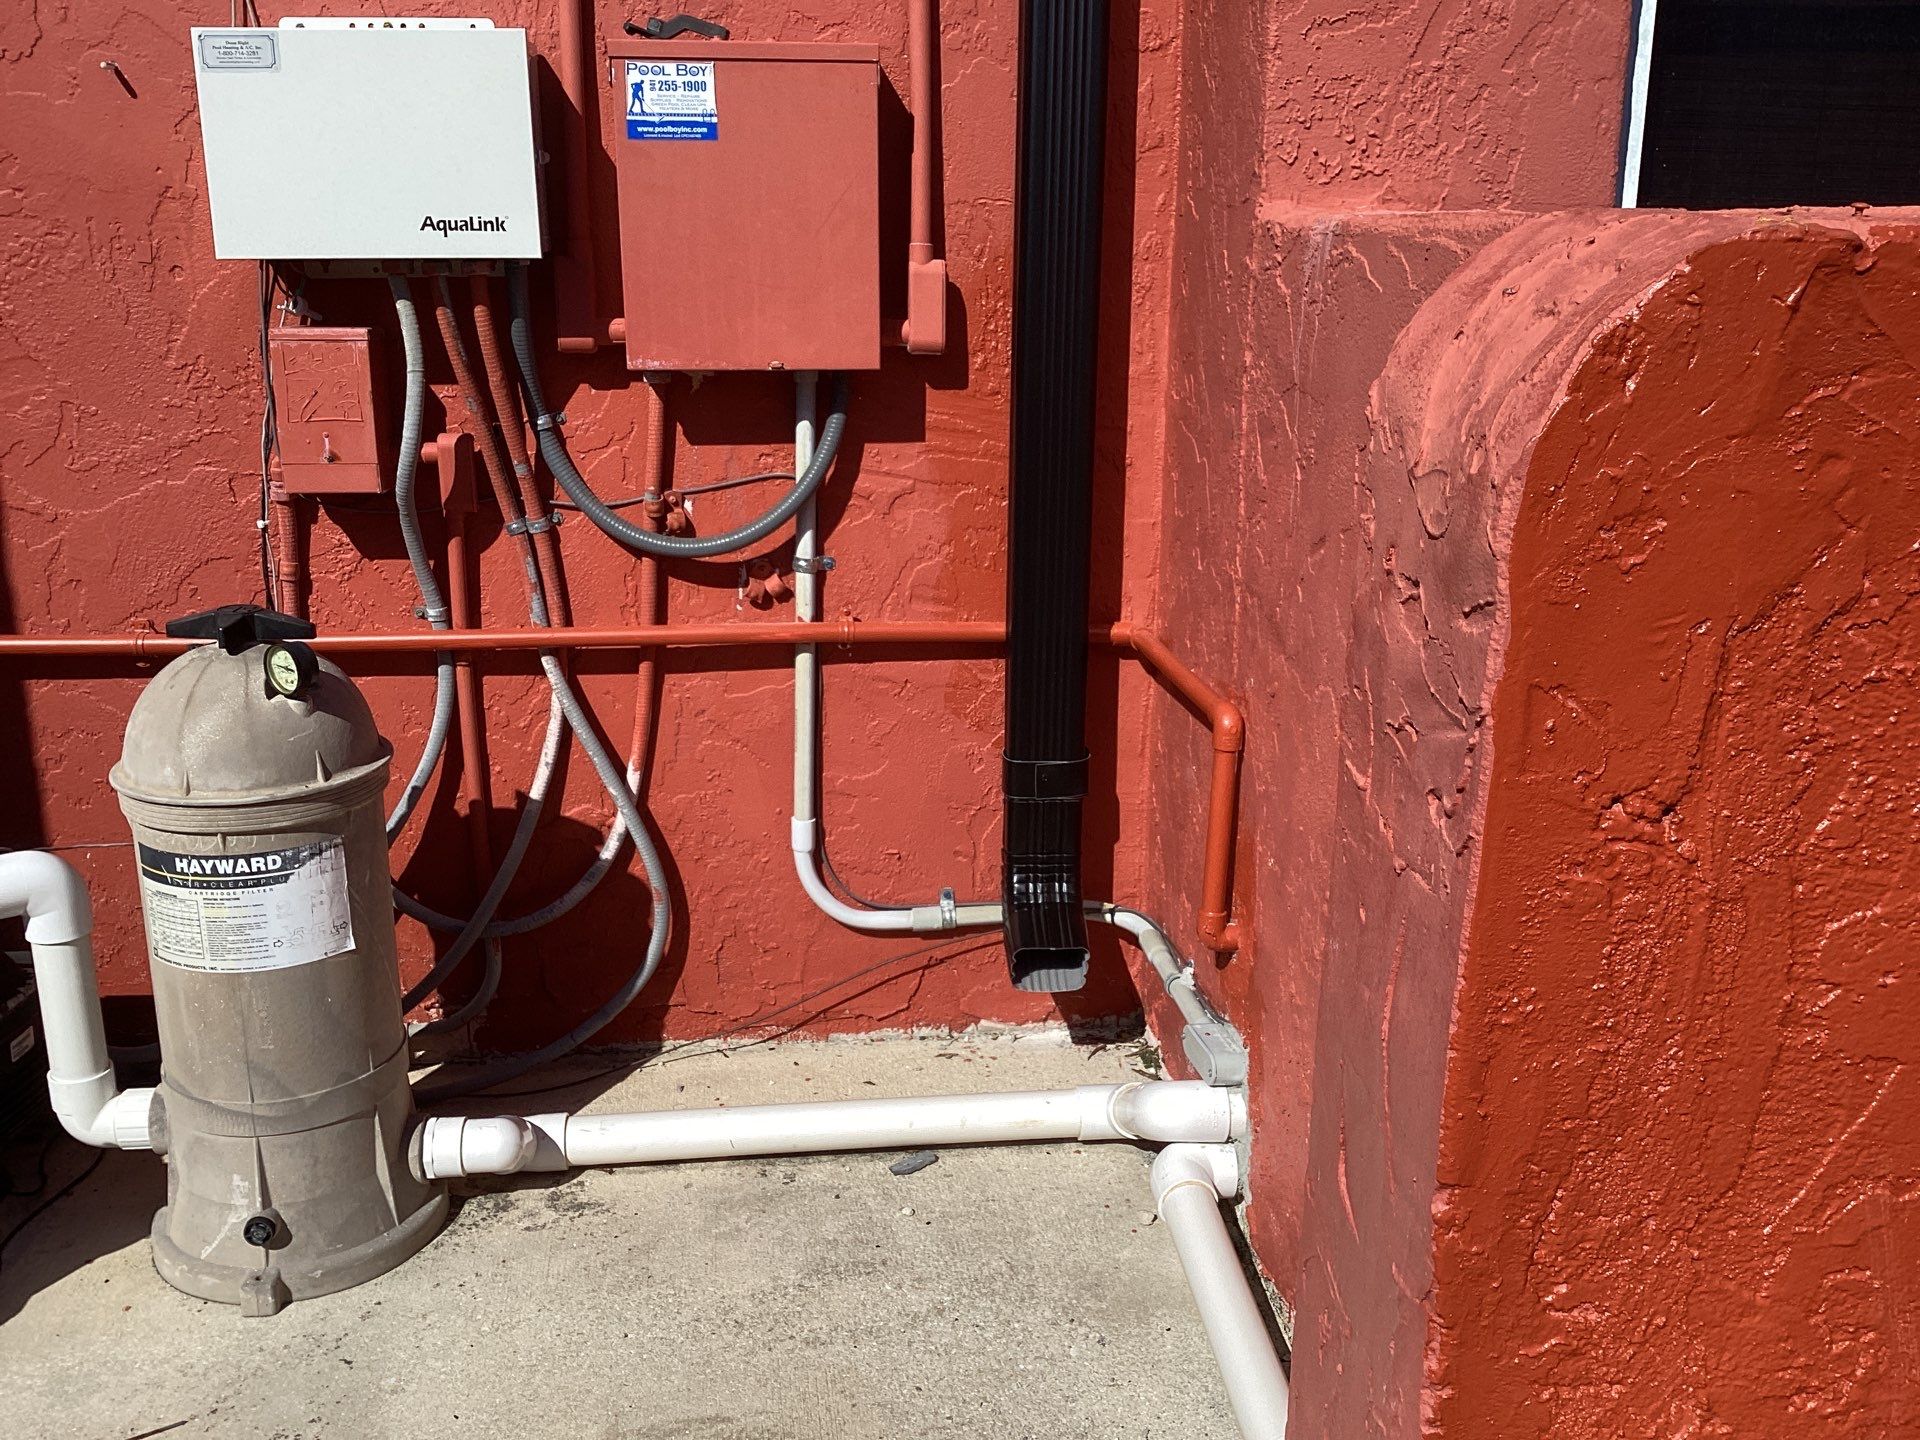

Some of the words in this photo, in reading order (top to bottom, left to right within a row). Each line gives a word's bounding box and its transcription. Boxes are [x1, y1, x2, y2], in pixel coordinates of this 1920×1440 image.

[626, 62, 671, 76] POOL
[676, 63, 708, 77] BOY
[657, 80, 707, 92] 255-1900
[636, 126, 708, 134] www.poolboyinc.com
[419, 215, 507, 237] AquaLink
[174, 855, 283, 874] HAYWARD
[260, 875, 286, 886] PLU
